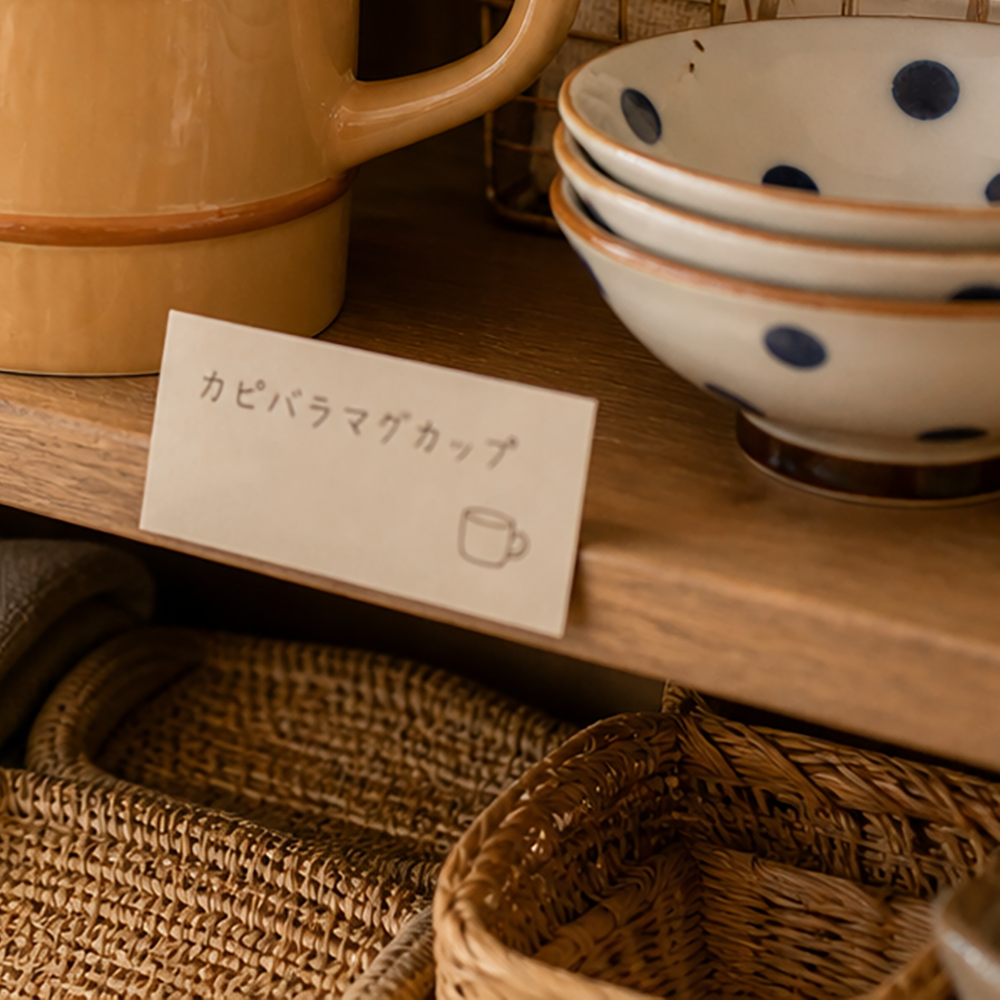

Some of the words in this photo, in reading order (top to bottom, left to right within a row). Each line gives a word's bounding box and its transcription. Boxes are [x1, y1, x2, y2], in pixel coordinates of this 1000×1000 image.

[199, 370, 519, 470] カピバラマグカップ
